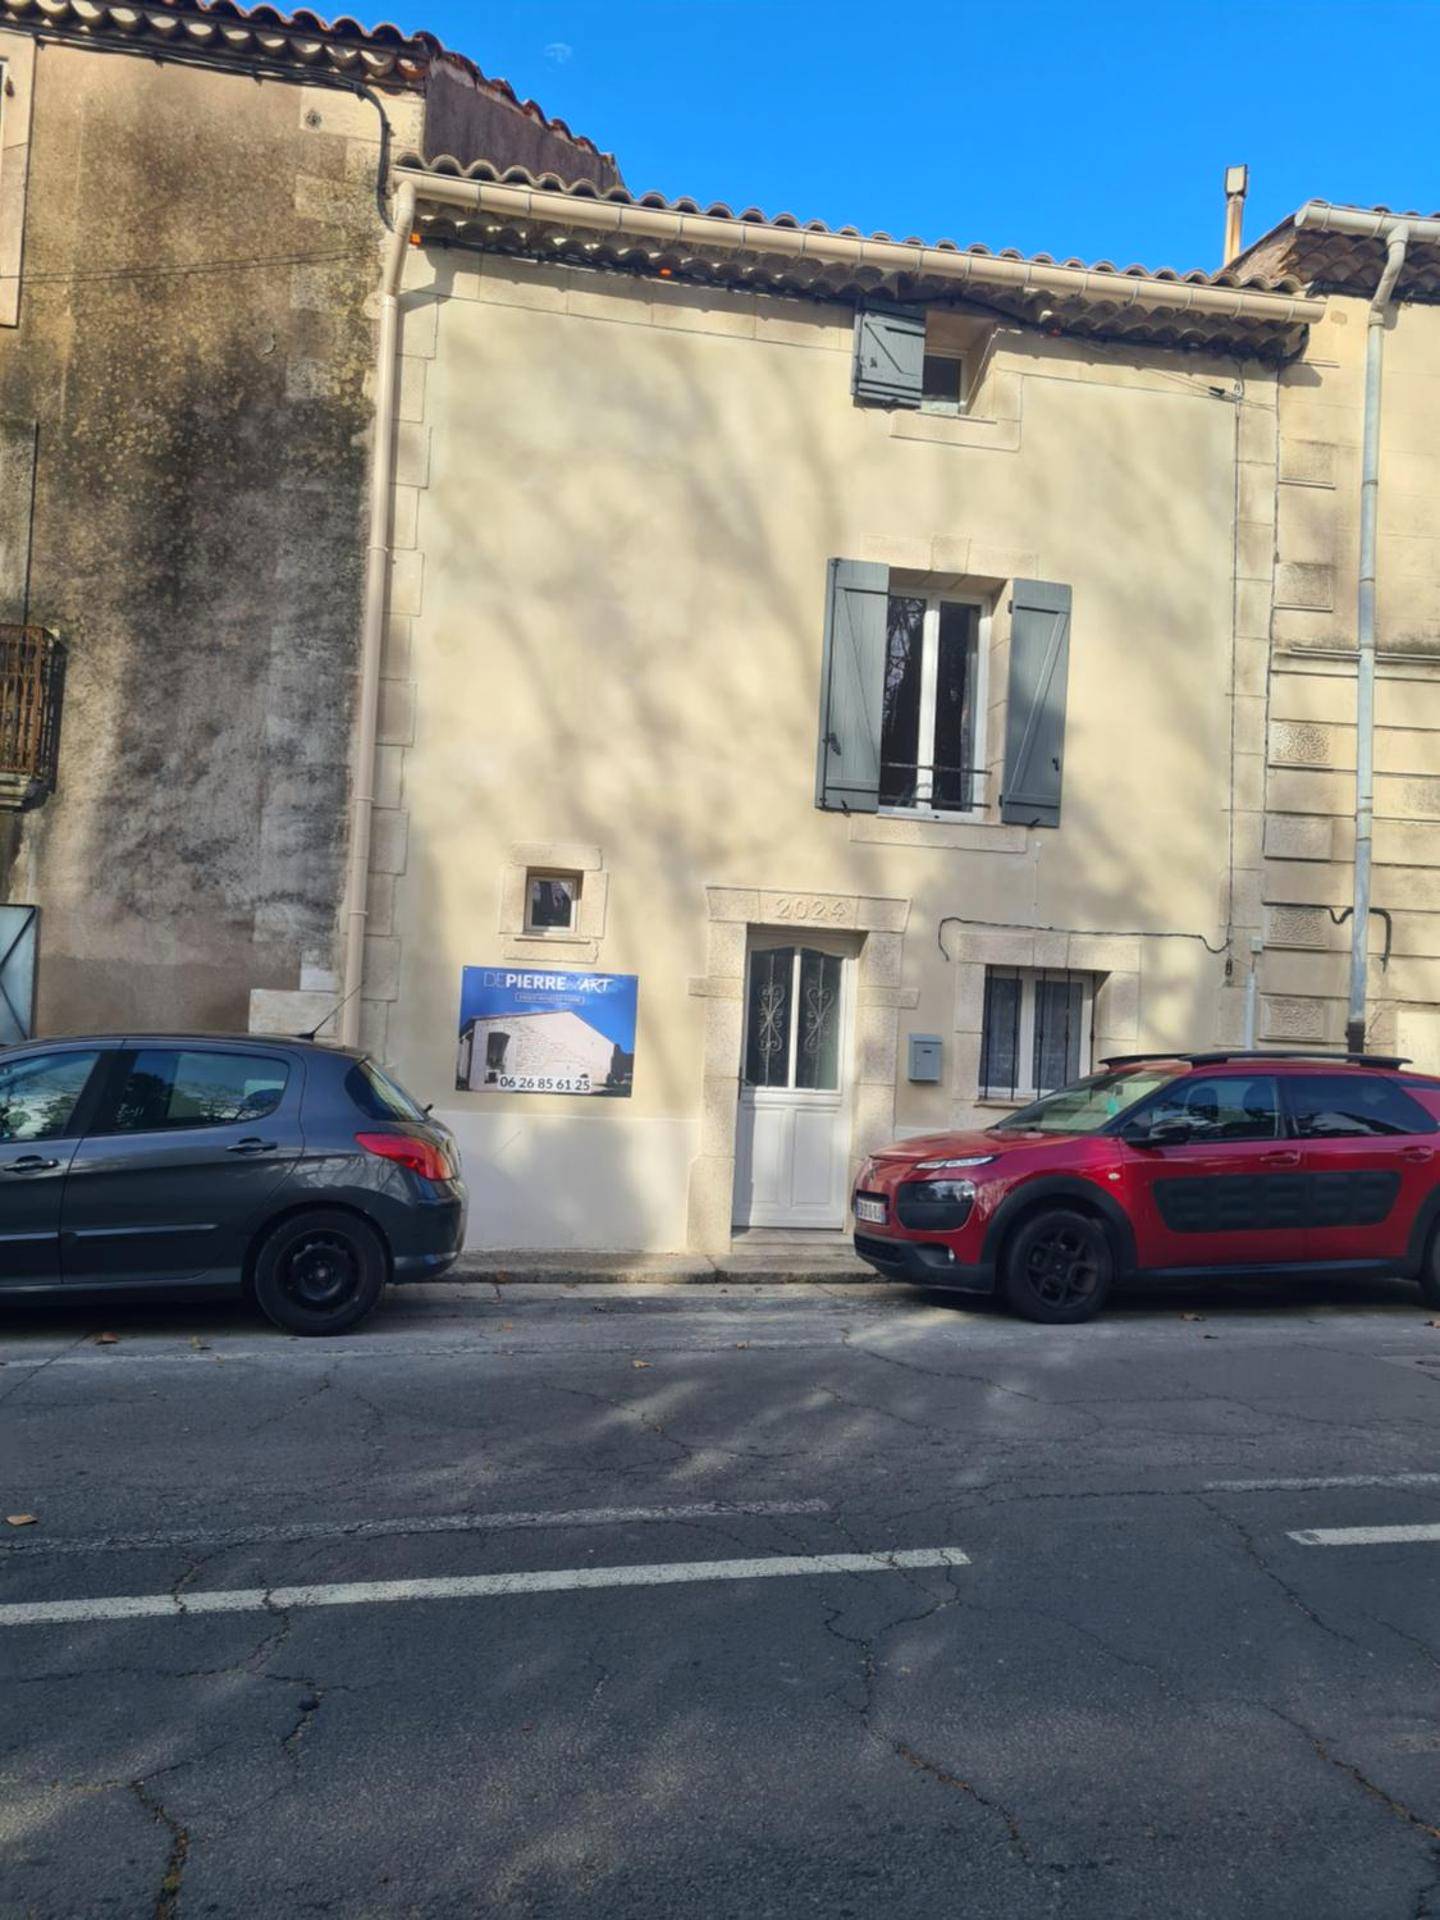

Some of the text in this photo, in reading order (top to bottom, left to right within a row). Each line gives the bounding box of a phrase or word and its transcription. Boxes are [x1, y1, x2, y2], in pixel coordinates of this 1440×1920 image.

[505, 973, 567, 991] PIERRE
[500, 1076, 591, 1091] 06 26 85 61 25
